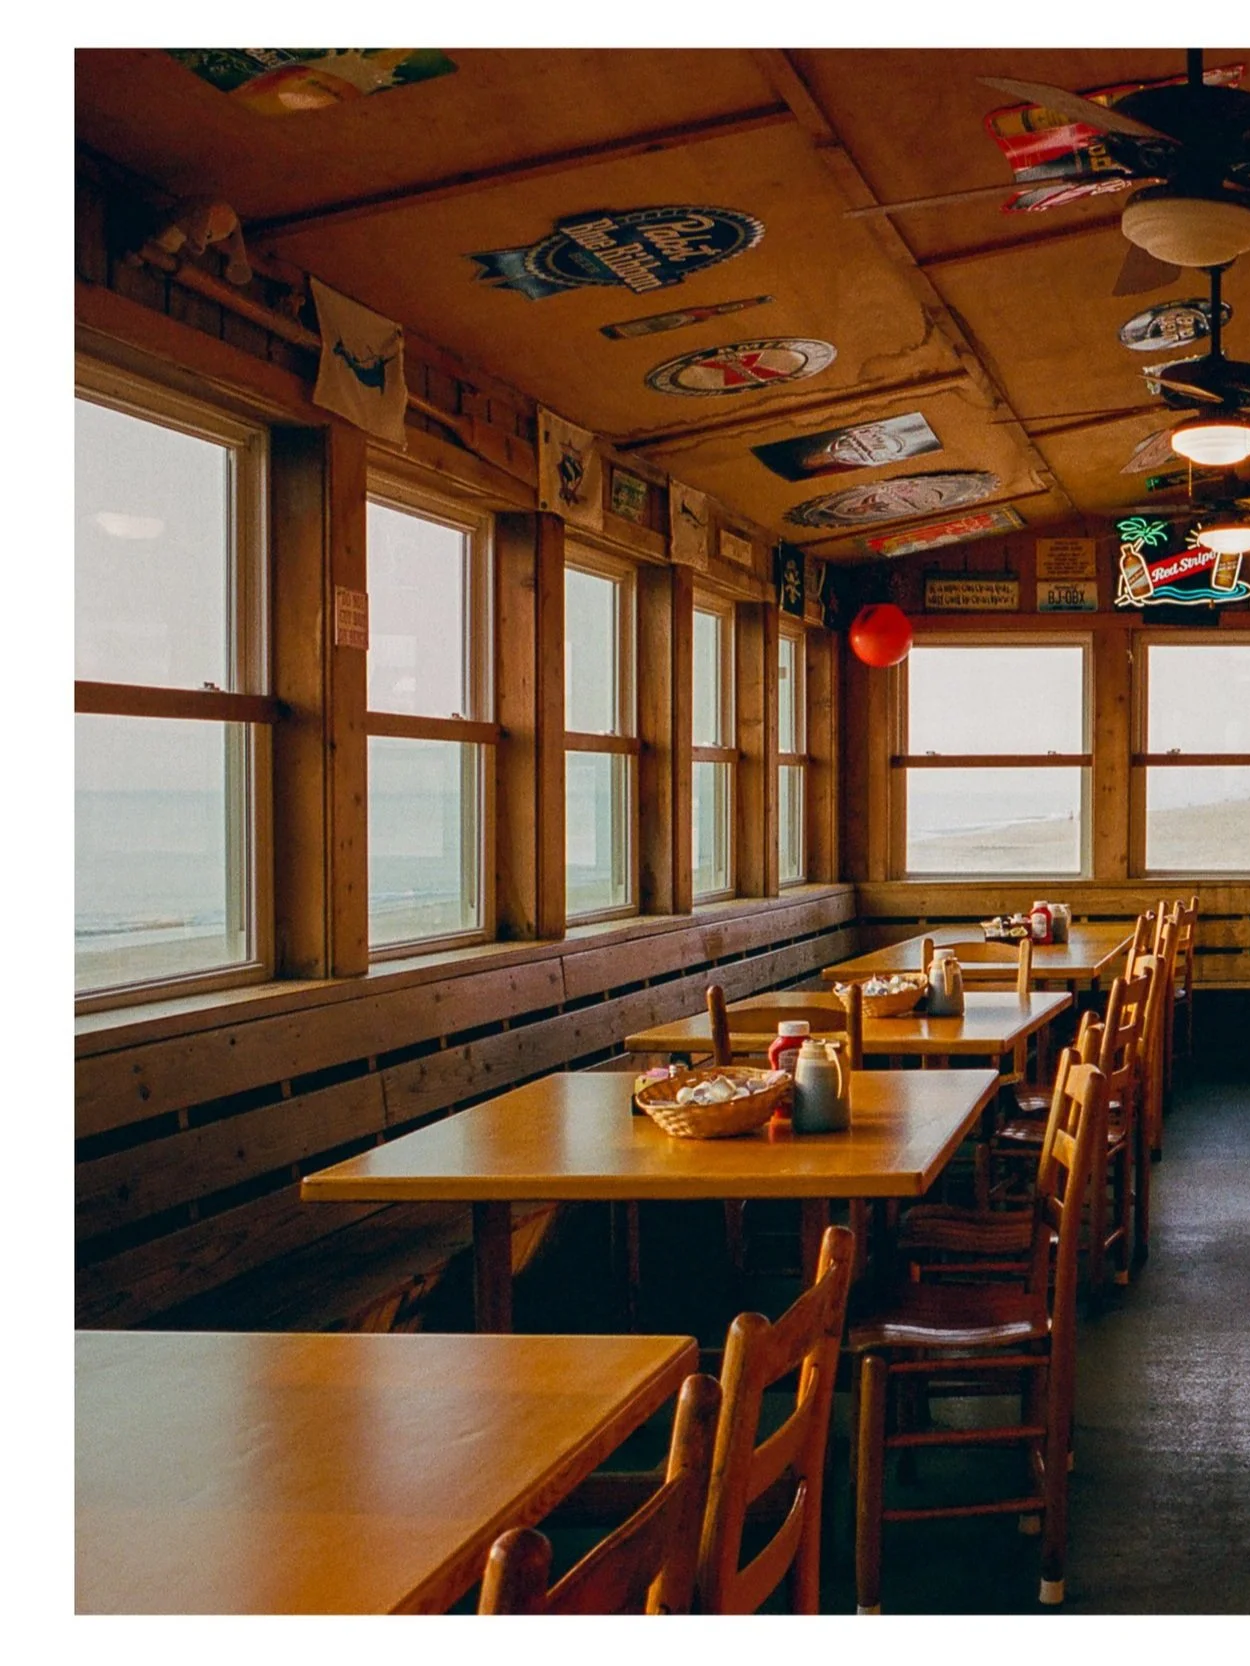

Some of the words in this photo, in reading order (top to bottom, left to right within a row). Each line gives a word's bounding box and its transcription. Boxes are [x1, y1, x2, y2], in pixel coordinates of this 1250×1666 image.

[560, 218, 619, 251] Blue
[601, 243, 663, 293] Ribbon
[637, 213, 721, 262] Pabst
[1151, 566, 1179, 583] Red
[1178, 550, 1217, 573] Stripe
